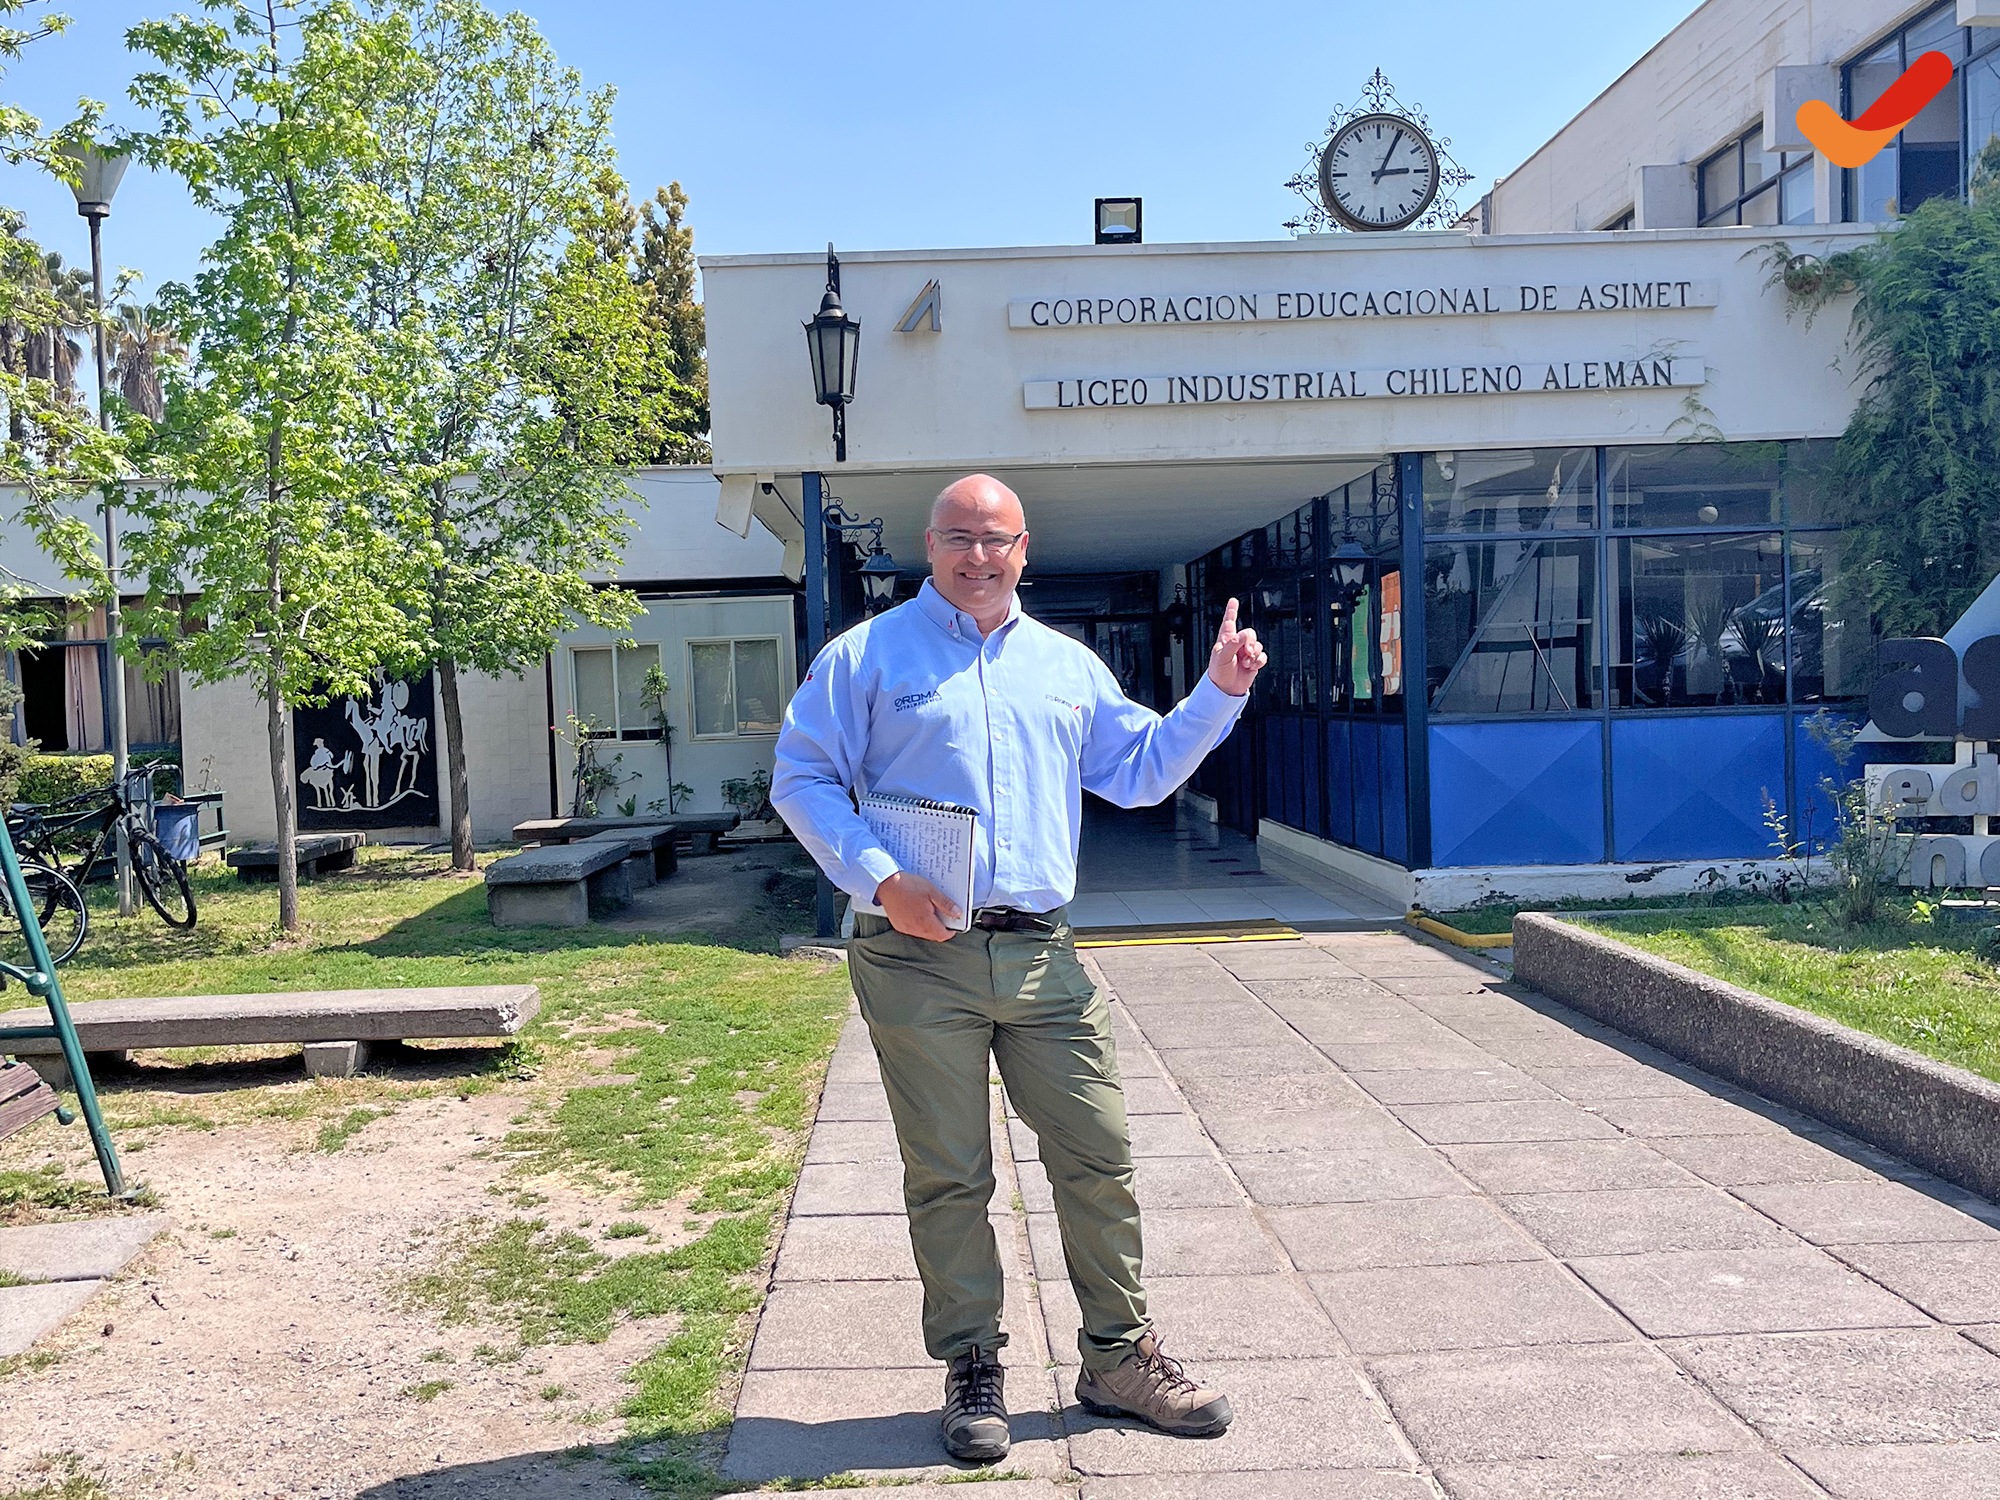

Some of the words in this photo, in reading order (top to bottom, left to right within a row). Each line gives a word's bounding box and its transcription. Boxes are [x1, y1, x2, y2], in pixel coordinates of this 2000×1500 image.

[1031, 294, 1258, 326] CORPORACION
[1277, 287, 1500, 319] EDUCACIONAL
[1520, 285, 1557, 311] DE
[1577, 281, 1692, 310] ASIMET
[1057, 378, 1148, 407] LICEO
[1167, 371, 1367, 404] INDUSTRIAL
[1386, 364, 1522, 396] CHILENO
